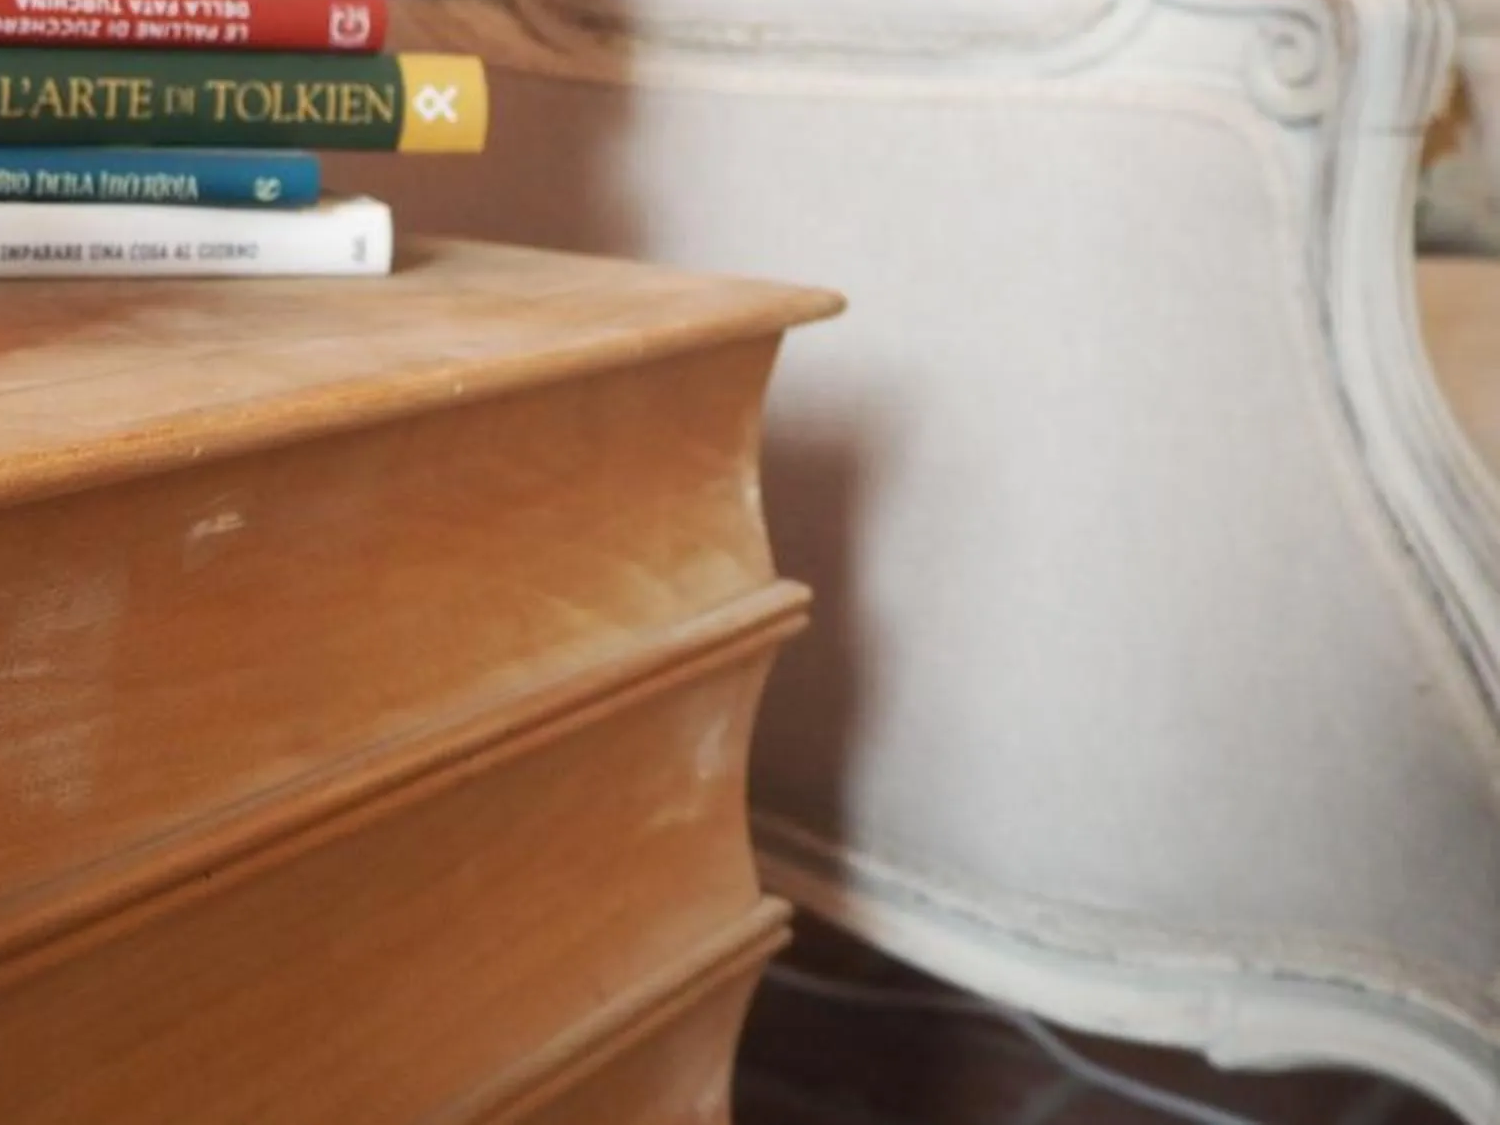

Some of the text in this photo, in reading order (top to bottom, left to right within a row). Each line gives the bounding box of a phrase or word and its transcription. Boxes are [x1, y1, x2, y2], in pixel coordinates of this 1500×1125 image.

[108, 19, 130, 38] DI
[135, 21, 219, 41] PALLINE
[224, 23, 249, 42] LE
[0, 76, 153, 119] L'ARTE
[163, 85, 194, 116] DI
[205, 79, 395, 125] TOLKIEN
[0, 242, 83, 262] IMPARARE
